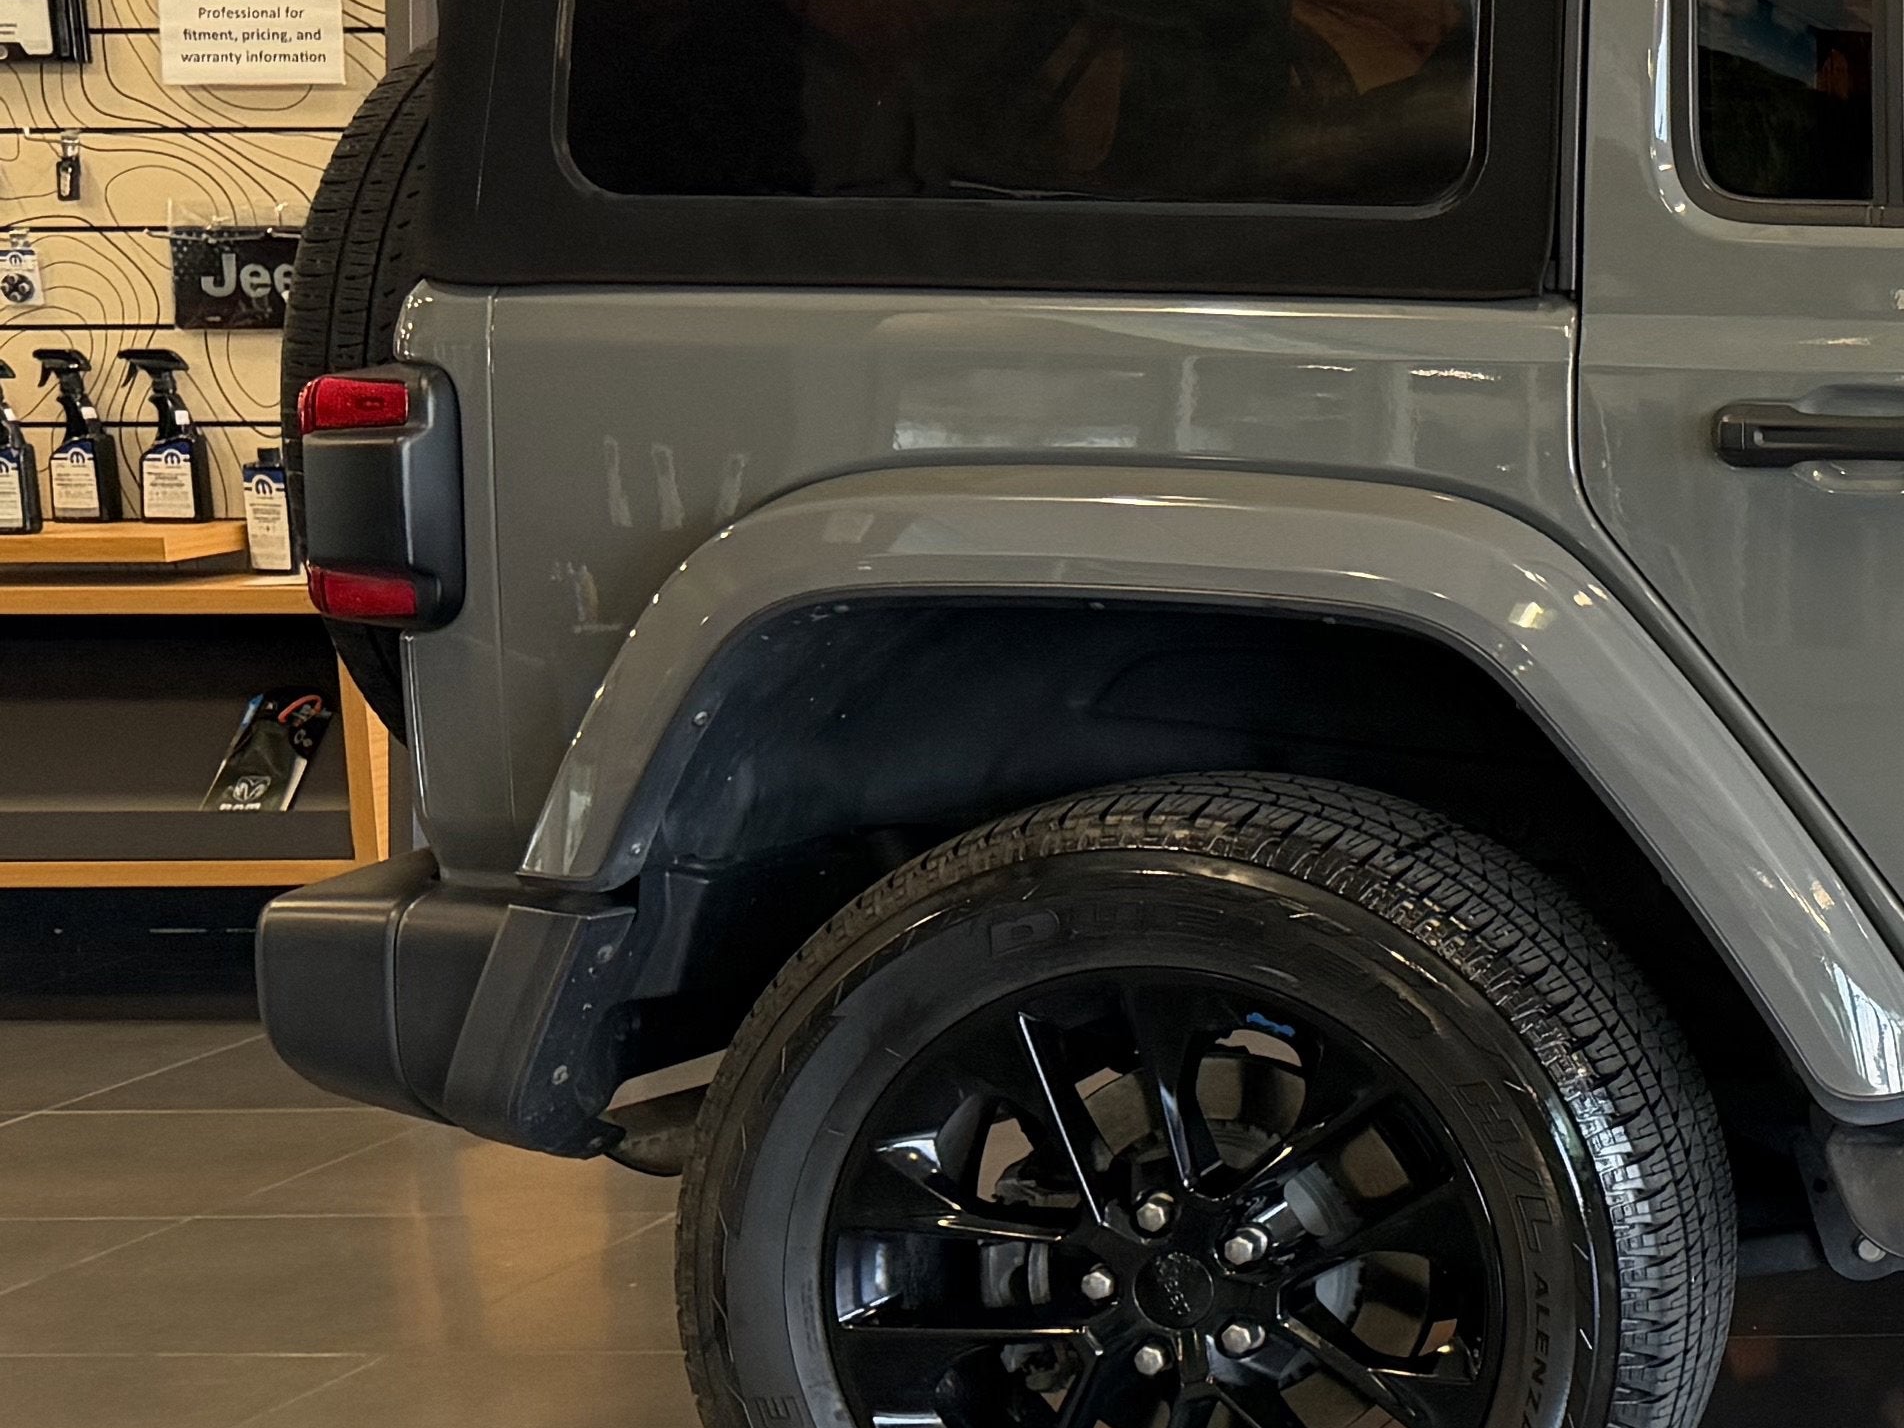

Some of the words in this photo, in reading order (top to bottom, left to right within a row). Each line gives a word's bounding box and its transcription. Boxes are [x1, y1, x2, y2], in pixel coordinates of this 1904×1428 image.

[198, 6, 280, 19] Professional
[285, 6, 304, 19] for
[183, 28, 238, 42] fitment,
[242, 28, 292, 43] pricing,
[296, 28, 321, 41] and
[181, 51, 242, 65] warranty
[246, 50, 327, 63] information
[201, 253, 294, 298] Jee
